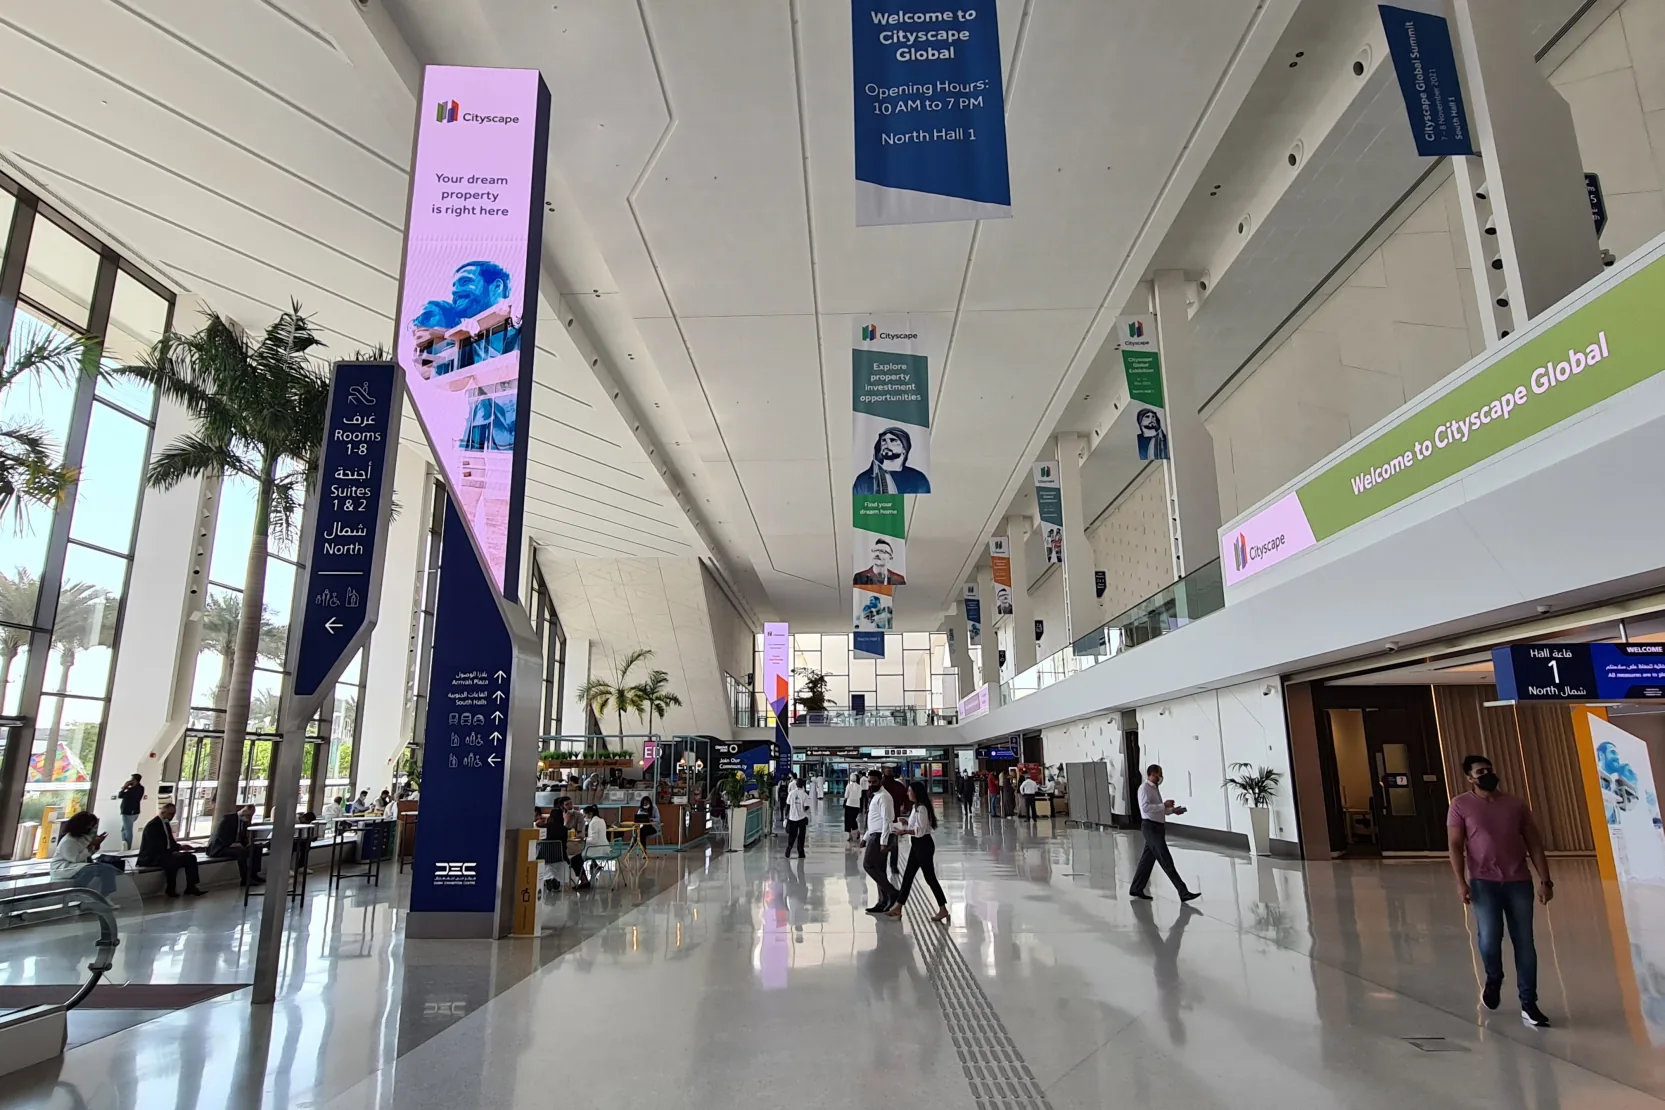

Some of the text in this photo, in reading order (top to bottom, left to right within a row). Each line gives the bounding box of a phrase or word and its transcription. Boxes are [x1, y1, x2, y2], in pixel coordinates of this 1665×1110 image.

[870, 9, 977, 25] Welcome to
[879, 30, 970, 45] Cityscape
[896, 47, 954, 61] Global
[1404, 21, 1436, 142] Cityscape Global Summit
[865, 79, 989, 99] Opening Hours:
[873, 96, 984, 115] 10 AM to 7 PM
[1434, 87, 1445, 124] November
[1448, 101, 1458, 117] Hall
[462, 112, 520, 126] Cityscape
[1452, 117, 1463, 140] South
[881, 127, 977, 145] North Hall 1
[435, 173, 508, 185] Your dream
[441, 190, 500, 202] property
[431, 204, 509, 217] is right here
[879, 332, 918, 340] Cityscape
[873, 362, 907, 371] Explore
[870, 373, 910, 382] property
[865, 383, 916, 391] investment
[859, 394, 921, 403] opportunities
[343, 412, 376, 427] غرف
[1350, 330, 1610, 496] Welcome to Cityscape Global
[334, 429, 381, 442] Rooms
[346, 444, 368, 456] 1-8
[334, 461, 372, 482] أجنحة
[330, 484, 372, 498] Suites
[333, 500, 367, 511] 1 & 2
[323, 521, 367, 539] شمال
[323, 542, 363, 555] North
[1248, 532, 1286, 562] Cityscape
[1530, 648, 1550, 658] Hall
[1552, 649, 1573, 658] قاعة
[1547, 659, 1560, 684] 1
[1528, 686, 1559, 696] North
[1560, 686, 1587, 697] شمال
[434, 862, 477, 875] DEC
